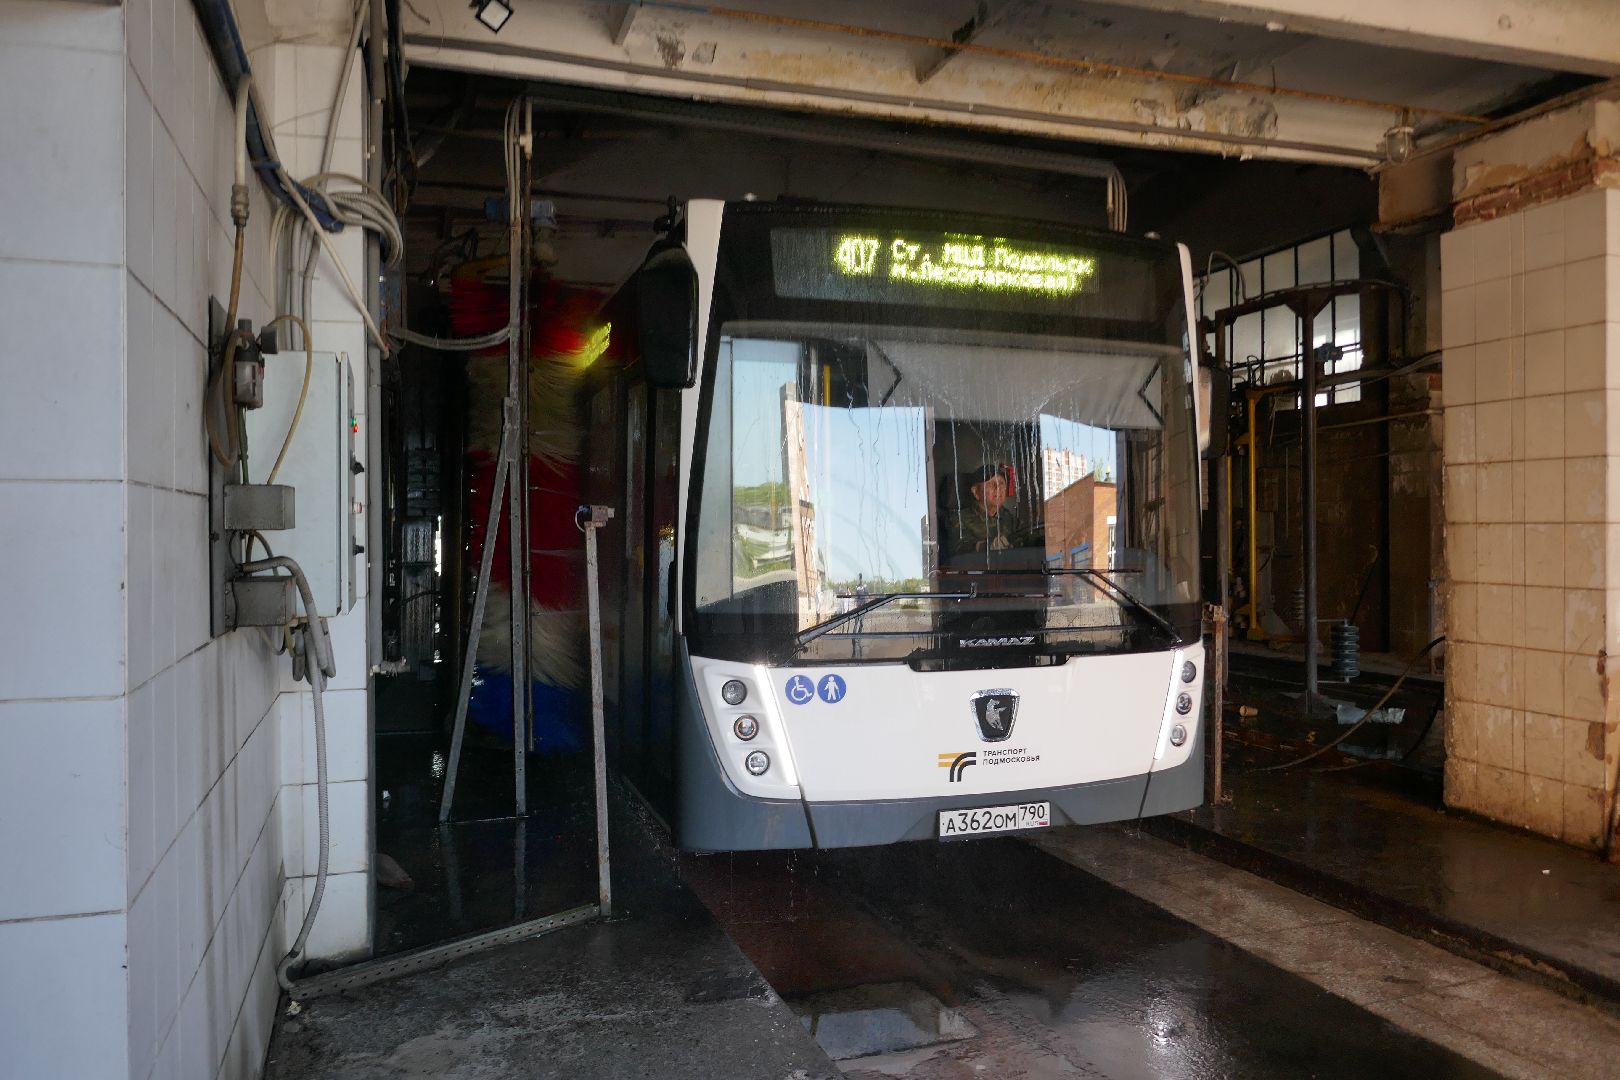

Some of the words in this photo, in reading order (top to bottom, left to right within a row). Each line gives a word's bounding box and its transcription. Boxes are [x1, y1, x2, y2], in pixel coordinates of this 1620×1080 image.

[838, 239, 879, 274] 407
[959, 636, 1035, 648] KAMAZ
[983, 748, 1027, 758] ТРАНСПОРТ
[983, 755, 1040, 766] ПОДМОСКОВЬЯ
[1019, 804, 1045, 821] 790
